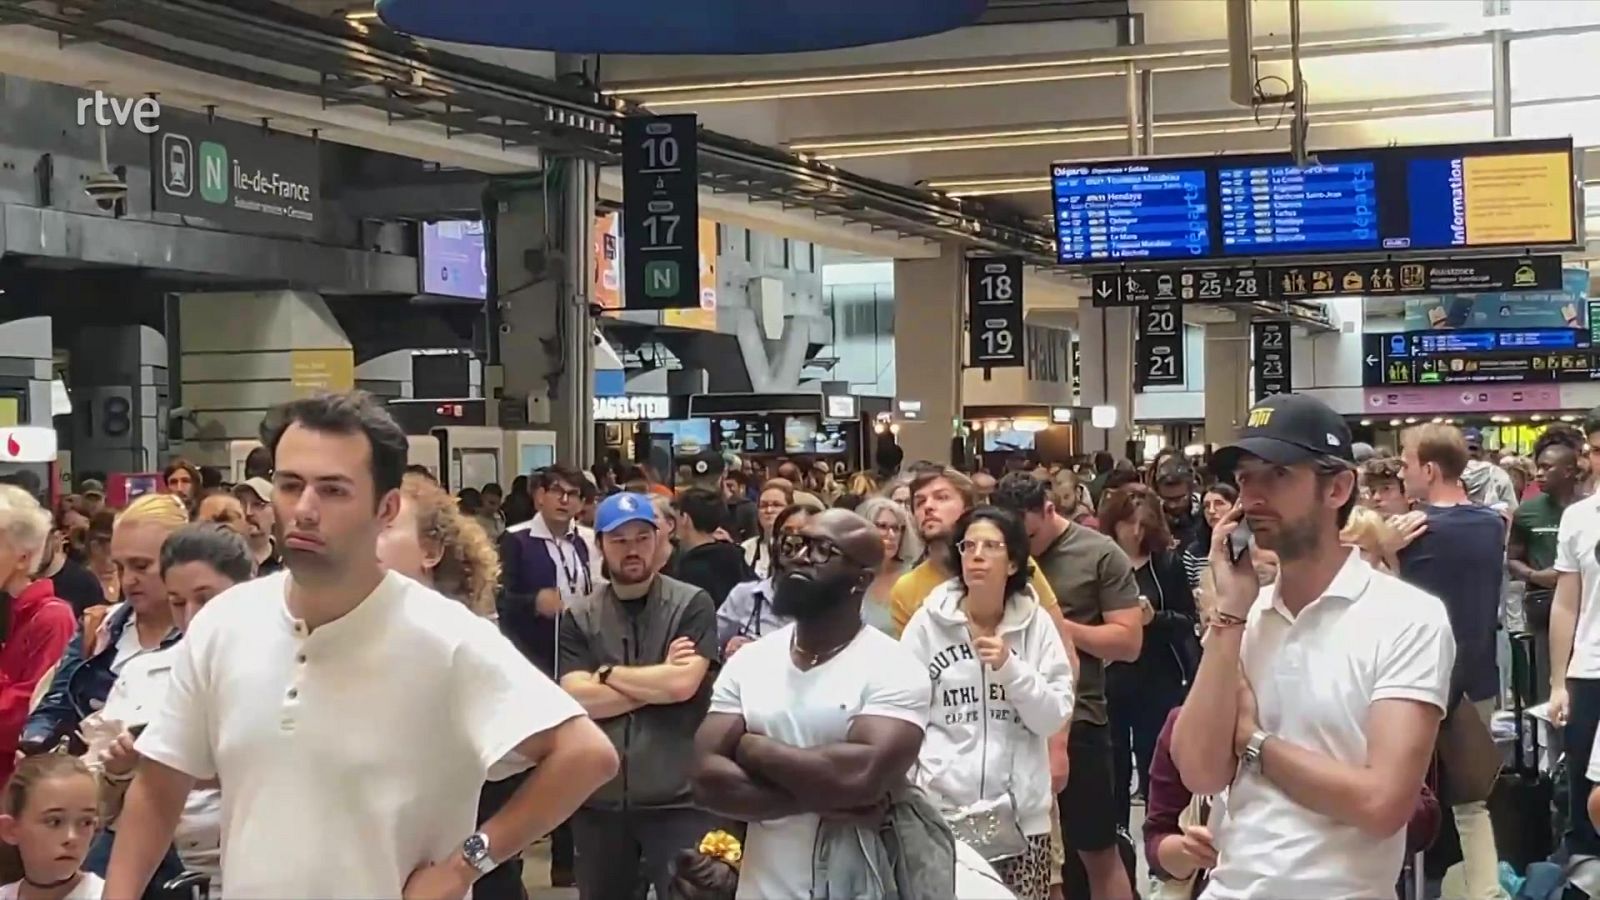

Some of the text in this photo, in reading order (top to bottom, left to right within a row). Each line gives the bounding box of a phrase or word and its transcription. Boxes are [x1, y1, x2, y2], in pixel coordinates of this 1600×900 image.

[642, 137, 679, 168] 10
[206, 156, 310, 202] N Île-de-France
[656, 176, 664, 189] à
[1449, 159, 1466, 245] Information
[643, 214, 680, 245] 17
[654, 268, 671, 289] N
[981, 275, 1012, 301] 18
[1200, 280, 1221, 296] 25
[1234, 278, 1257, 295] 28
[1147, 311, 1174, 332] 20
[981, 330, 1012, 354] 19
[1262, 334, 1283, 347] 22
[1149, 355, 1174, 375] 21
[1262, 361, 1283, 376] 23
